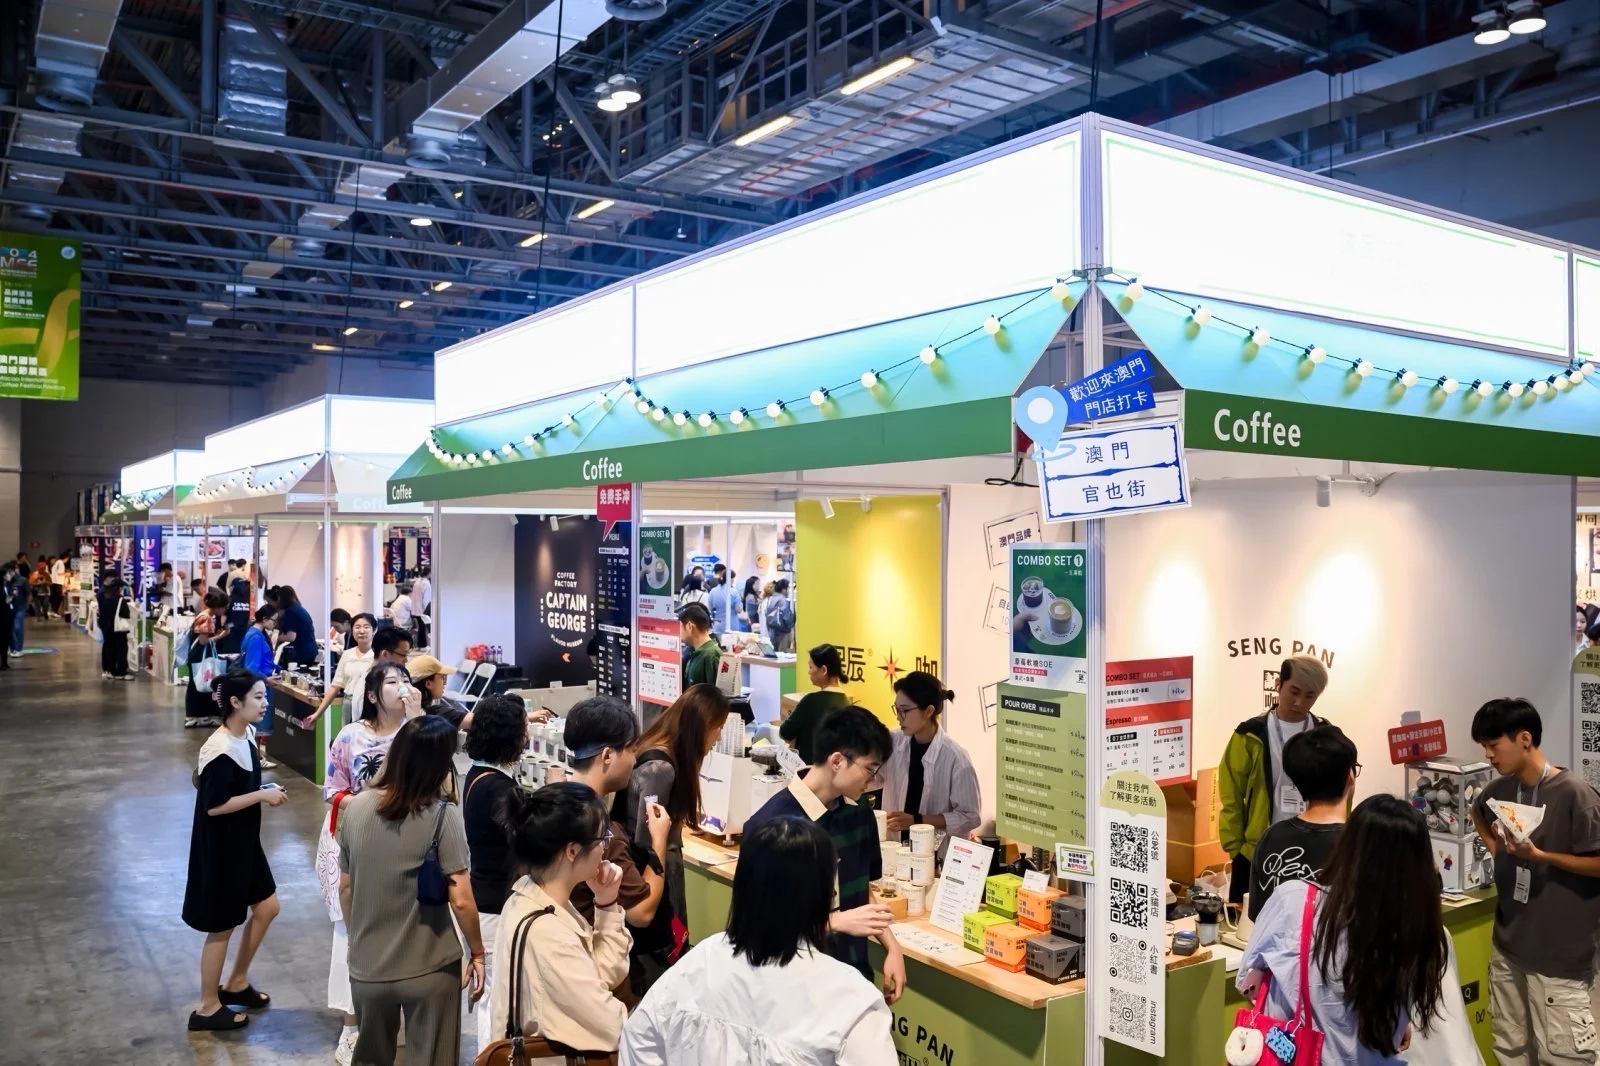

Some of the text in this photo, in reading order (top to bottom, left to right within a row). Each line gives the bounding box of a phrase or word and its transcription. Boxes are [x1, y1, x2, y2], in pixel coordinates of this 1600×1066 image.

[1068, 356, 1147, 403] 歡迎來澳門
[1084, 389, 1148, 419] 門店打卡
[1214, 408, 1301, 448] Coffee
[1085, 441, 1130, 464] 澳門
[582, 456, 623, 482] Coffee
[392, 484, 413, 501] Coffee
[1082, 479, 1147, 504] 官也街
[1017, 555, 1052, 567] COMBO
[1054, 555, 1073, 567] SET
[554, 580, 578, 588] FACTORY
[556, 572, 575, 580] COFFEE
[546, 591, 588, 612] CAPTAIN
[547, 611, 587, 633] GEORGE
[1228, 637, 1335, 669] SENG PAN
[1106, 672, 1128, 682] COMBO
[1128, 671, 1141, 681] SET
[1004, 699, 1020, 708] POUR
[1020, 702, 1037, 712] OVER
[1106, 716, 1132, 726] Espresso
[1153, 729, 1158, 737] 2
[1116, 780, 1150, 794] 關注我們
[1109, 790, 1157, 808] 了解更多活動
[1150, 887, 1160, 917] 天貓店
[1148, 1000, 1158, 1045] instagram
[915, 1024, 954, 1066] PAN
